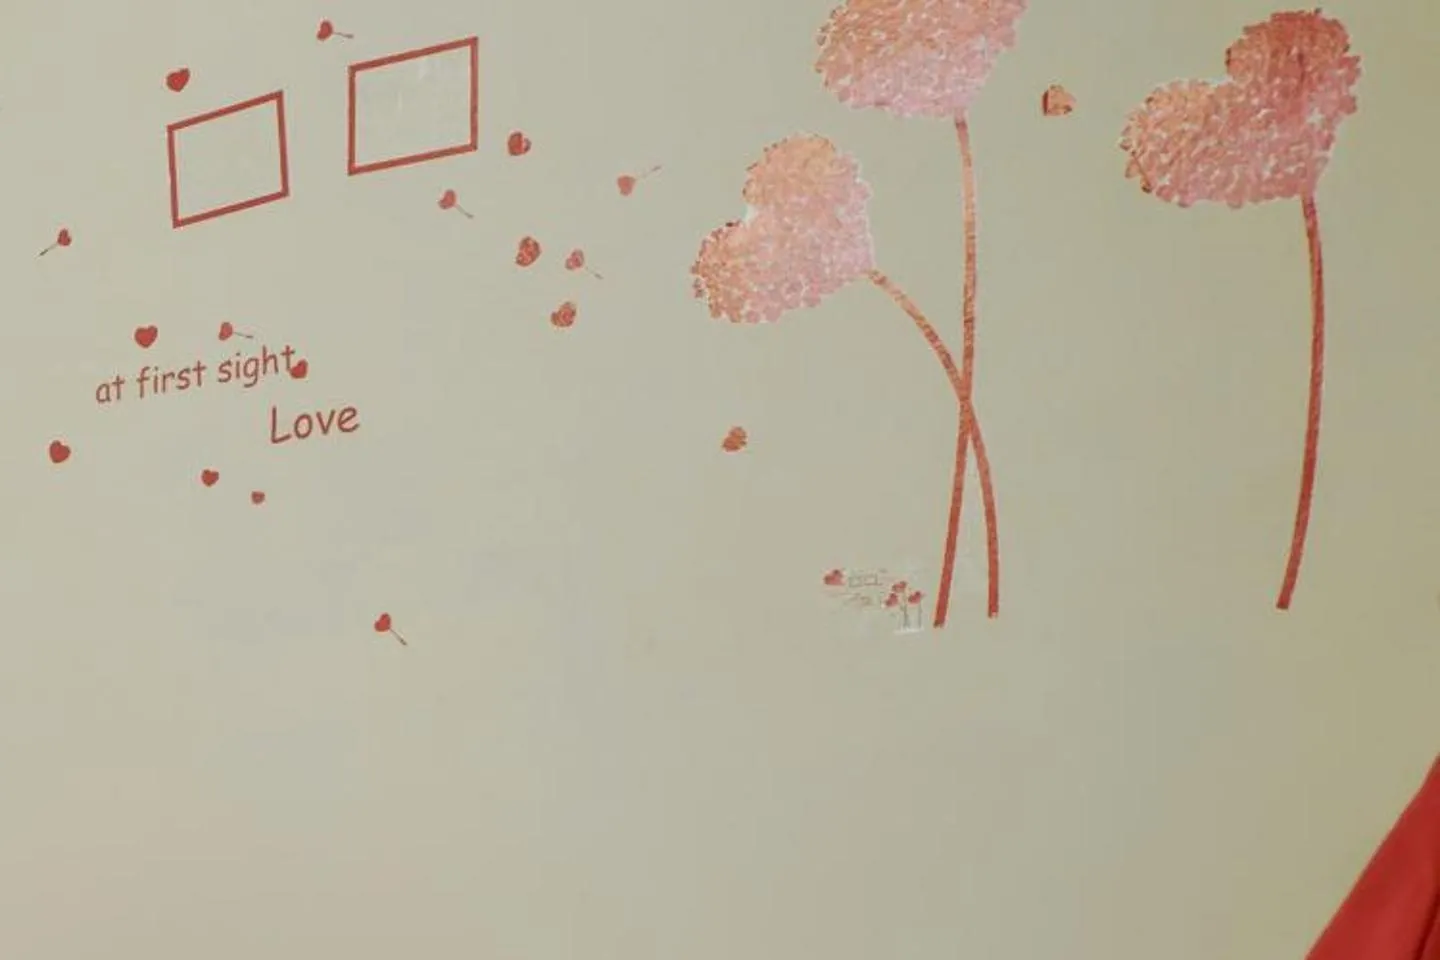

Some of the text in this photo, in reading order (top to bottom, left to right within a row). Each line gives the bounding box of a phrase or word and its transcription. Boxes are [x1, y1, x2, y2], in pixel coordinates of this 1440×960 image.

[95, 345, 296, 402] at first sight
[270, 405, 360, 444] Love
